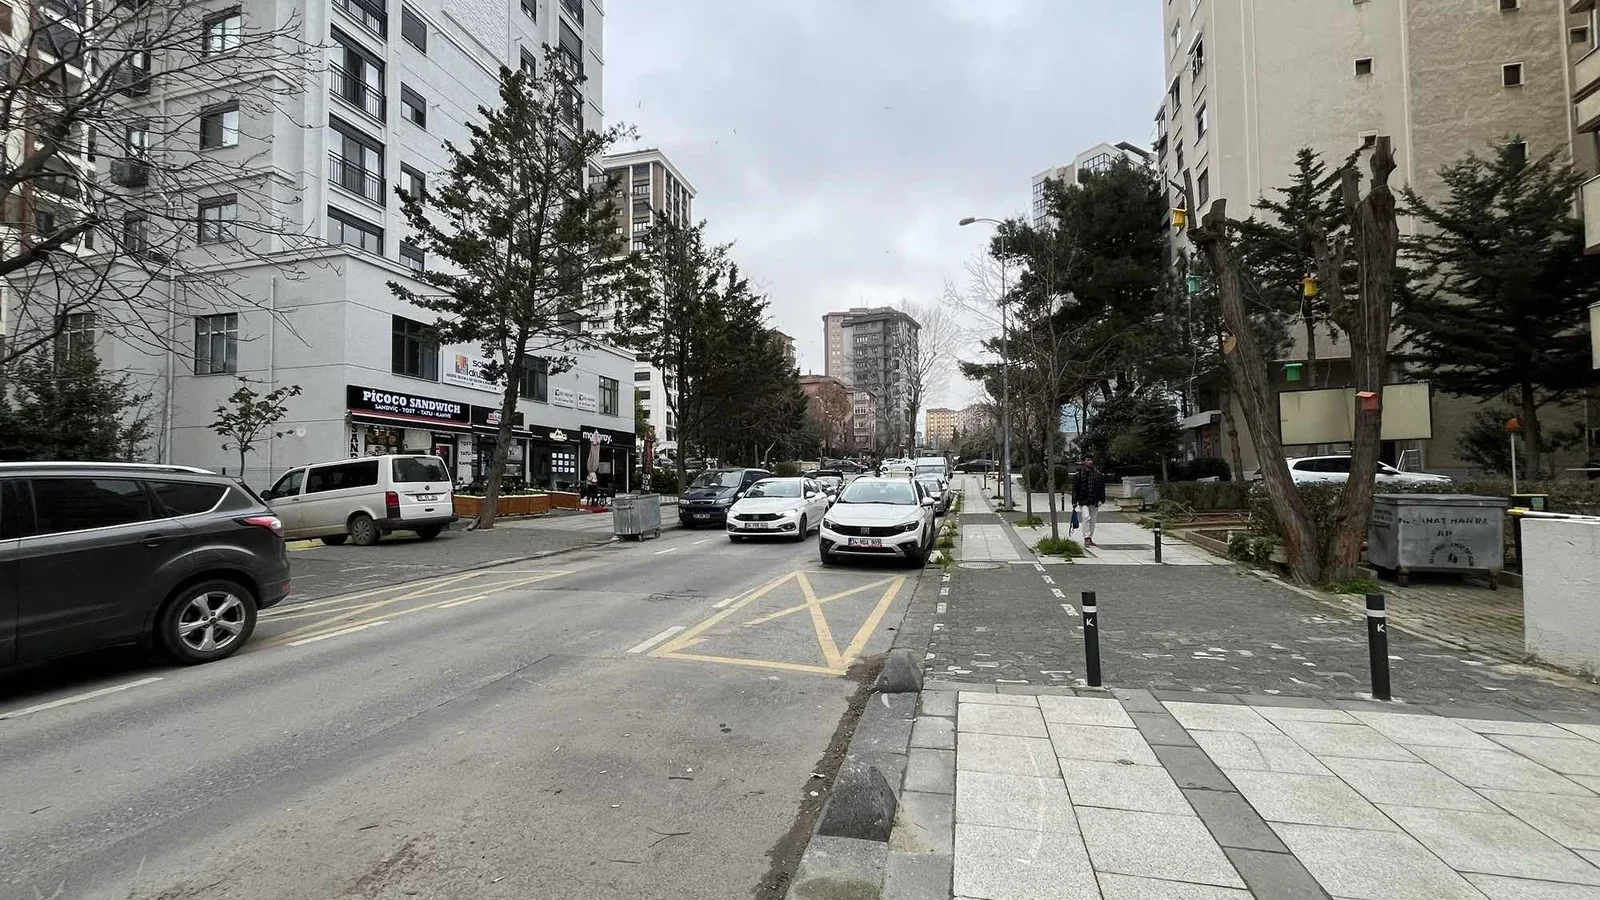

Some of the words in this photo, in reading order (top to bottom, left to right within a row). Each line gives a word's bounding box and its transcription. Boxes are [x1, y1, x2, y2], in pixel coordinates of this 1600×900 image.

[363, 390, 407, 406] PİCOCO
[410, 398, 461, 414] SANDWICH
[1086, 618, 1095, 627] K
[1377, 623, 1386, 633] K
